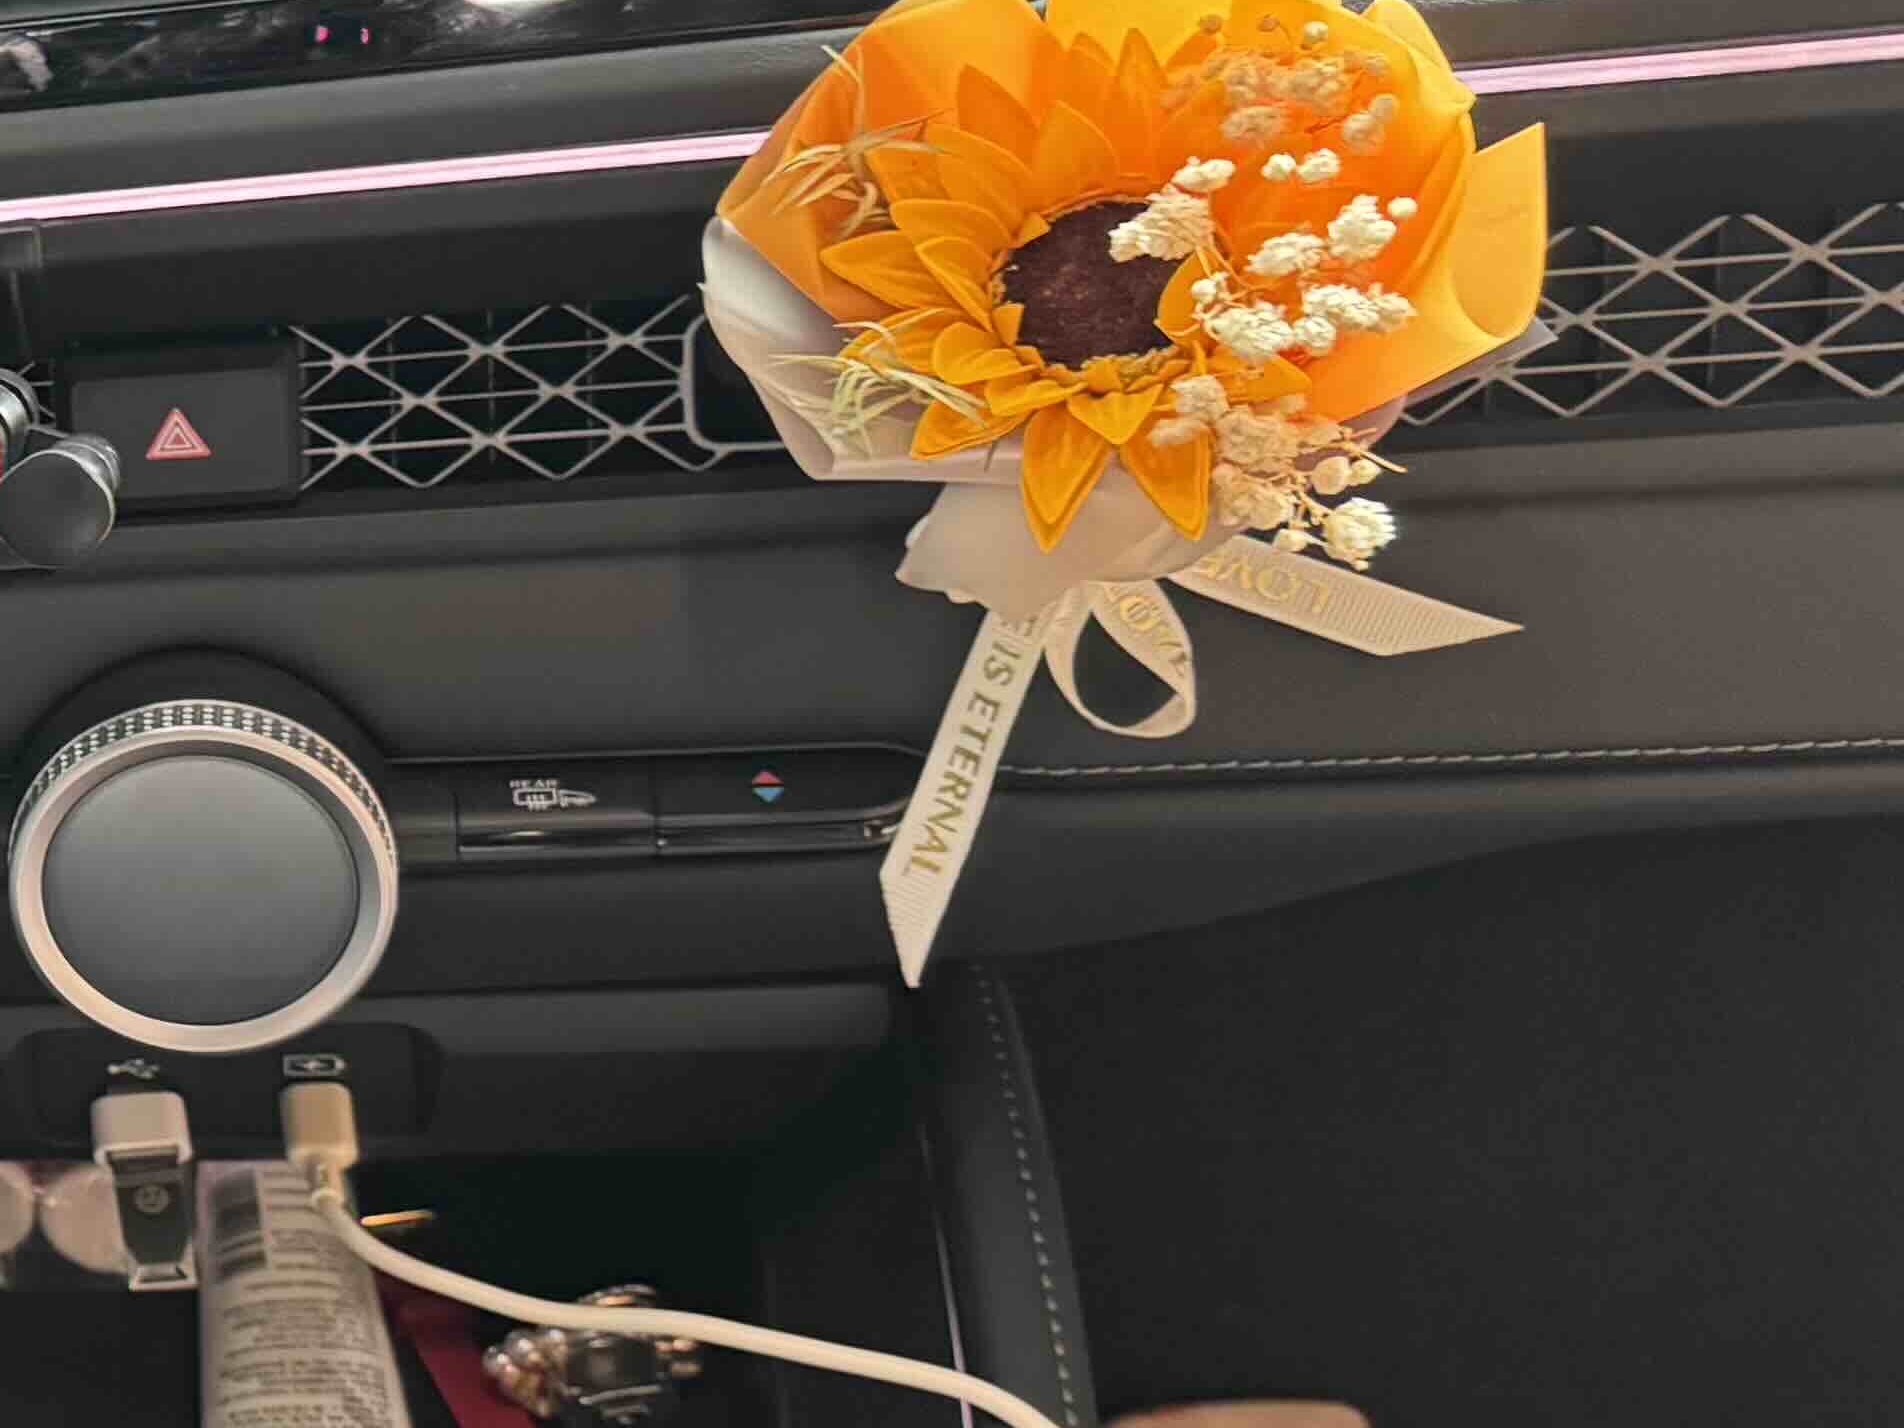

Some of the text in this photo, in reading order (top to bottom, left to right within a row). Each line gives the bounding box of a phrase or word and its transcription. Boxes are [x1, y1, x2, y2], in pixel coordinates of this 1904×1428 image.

[983, 639, 1022, 687] IS
[509, 779, 558, 789] REAR
[902, 690, 1002, 877] ETERNAL
